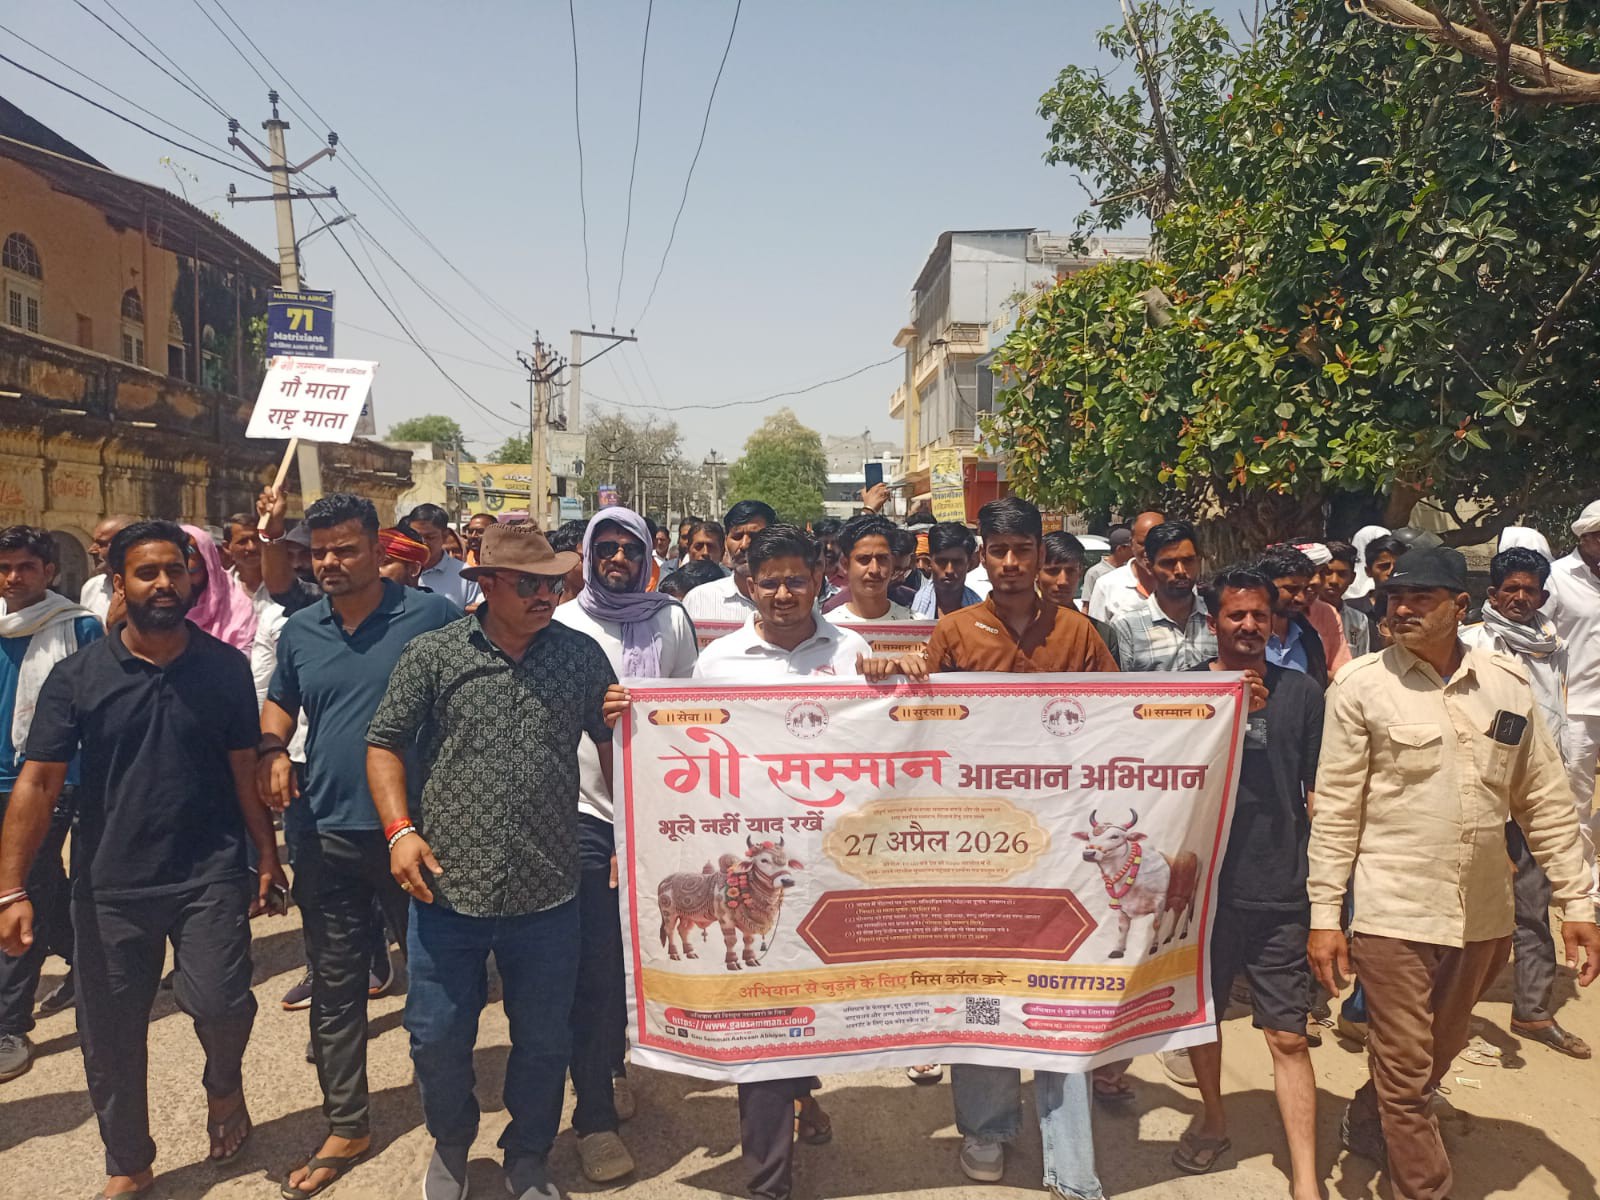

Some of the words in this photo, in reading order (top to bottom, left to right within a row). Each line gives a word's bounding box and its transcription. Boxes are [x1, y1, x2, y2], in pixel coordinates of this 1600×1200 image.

[287, 308, 313, 331] 71
[273, 331, 325, 343] Matrixians
[280, 375, 302, 398] गौ
[305, 382, 350, 401] माता
[268, 408, 299, 431] राष्ट्र
[303, 410, 349, 430] माता
[677, 710, 700, 722] सेवा
[912, 708, 944, 720] सुरक्षा
[1153, 708, 1193, 718] सम्मान
[754, 749, 952, 808] सम्मान
[1080, 756, 1208, 791] अभियान
[658, 814, 696, 842] भूले
[699, 812, 741, 836] नहीं
[744, 816, 784, 834] याद
[787, 809, 825, 832] रखें
[844, 832, 878, 857] 27
[886, 820, 950, 853] अप्रैल
[955, 831, 1029, 854] 2026
[739, 982, 801, 998] अभियान
[803, 979, 818, 994] से
[821, 976, 857, 997] जुड़ने
[859, 974, 875, 989] के
[878, 972, 908, 990] लिए
[910, 970, 942, 986] मिस
[945, 970, 979, 985] कॉल
[1027, 974, 1126, 991] 9067777323
